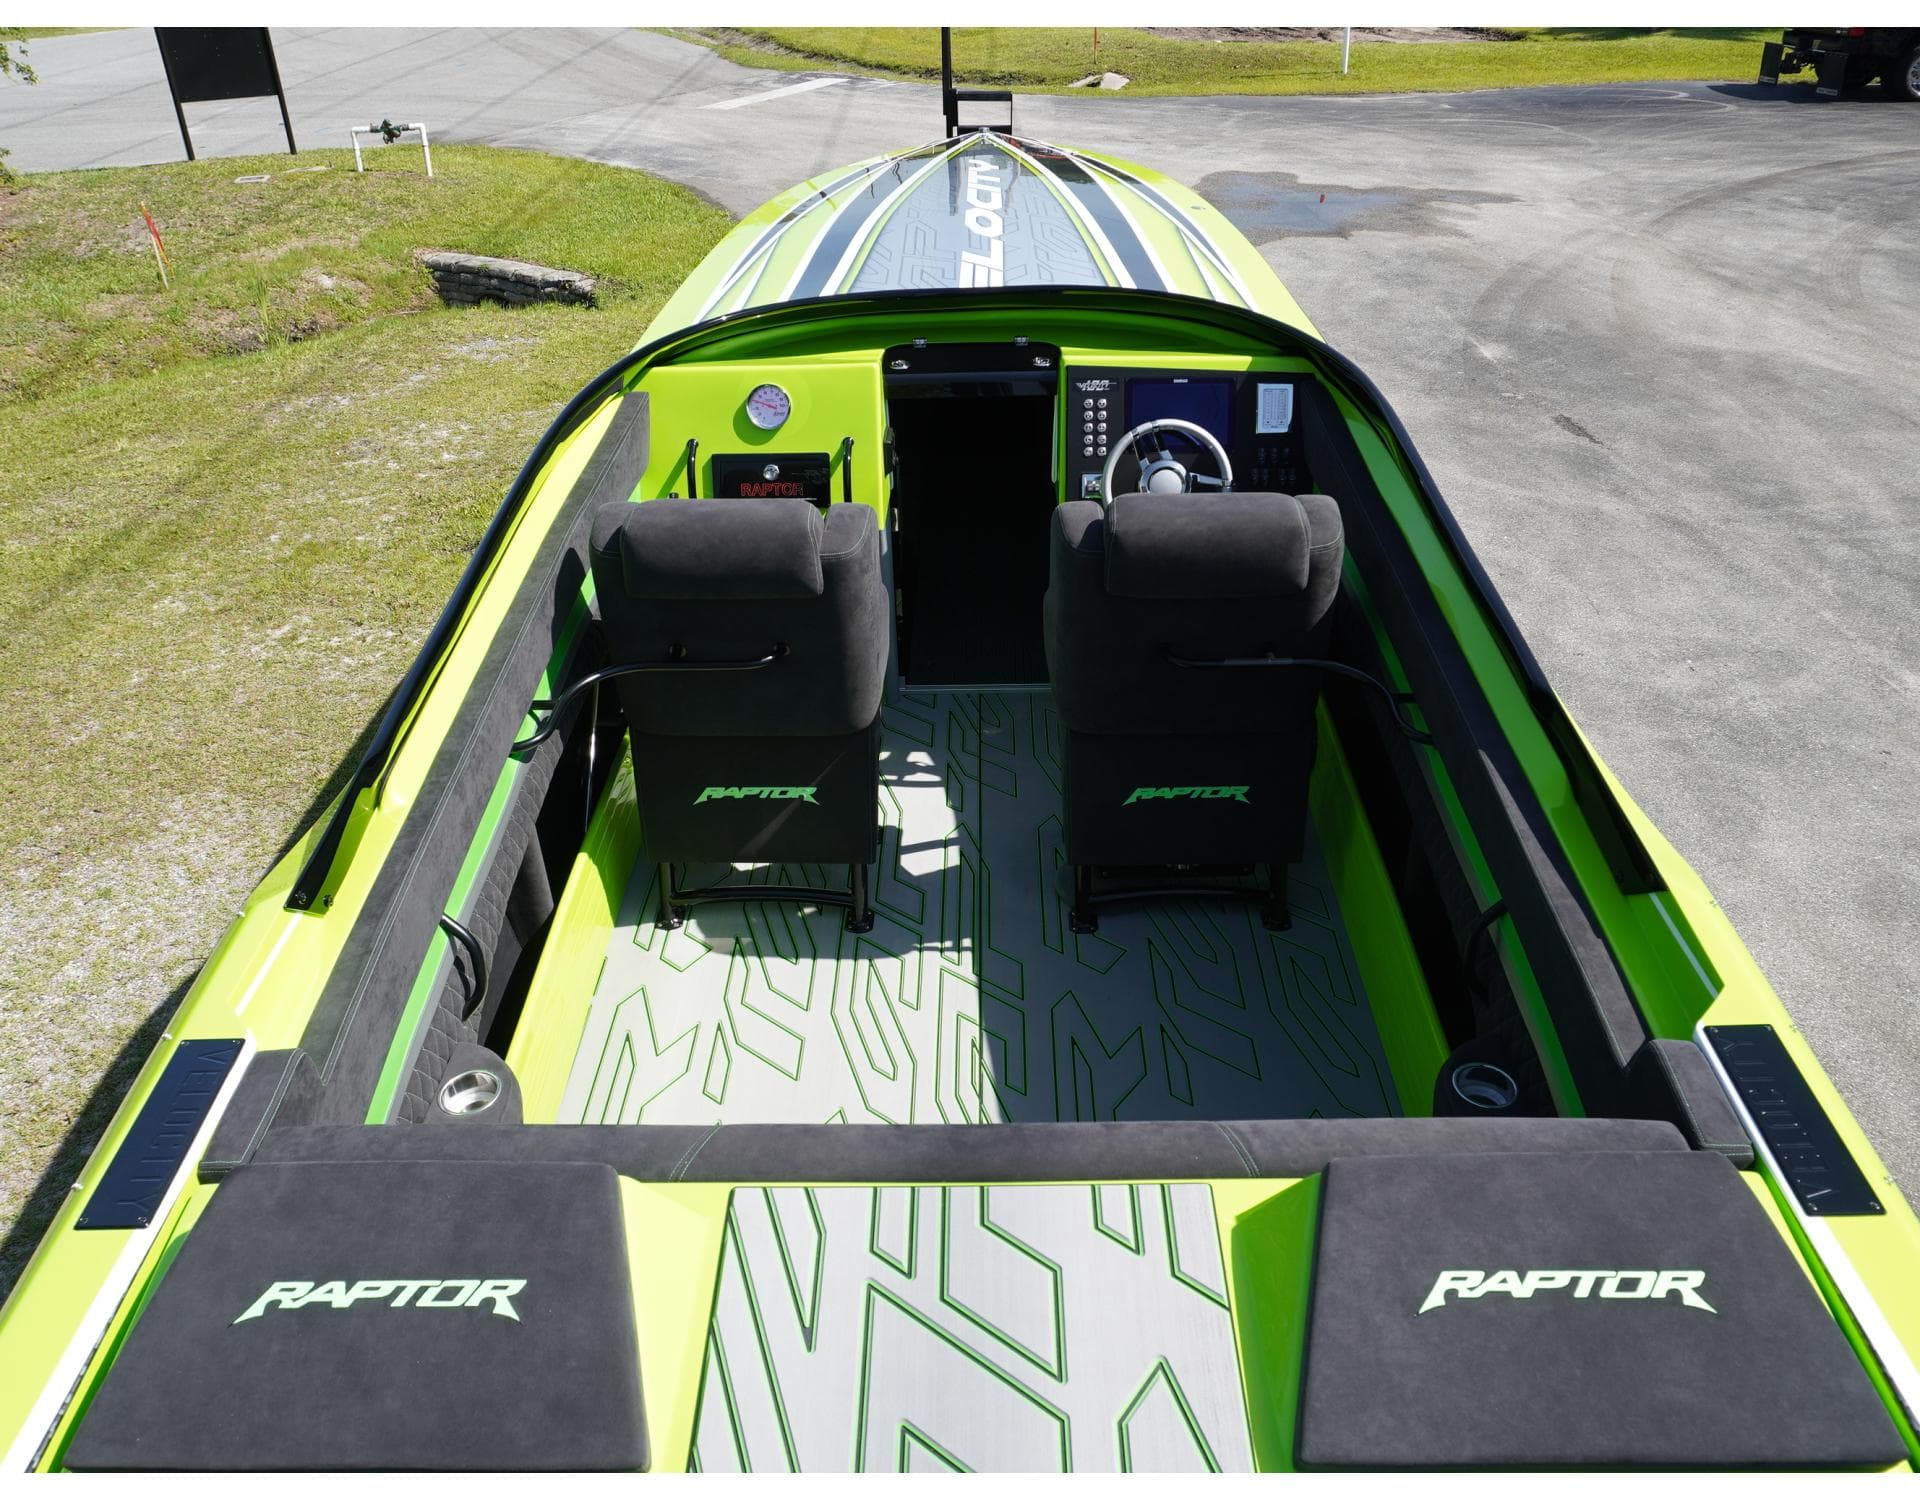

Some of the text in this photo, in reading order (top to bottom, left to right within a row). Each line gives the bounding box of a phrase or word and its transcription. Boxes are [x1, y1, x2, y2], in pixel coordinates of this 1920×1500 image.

[959, 159, 1004, 288] ELOCITY
[741, 482, 803, 497] RAPTOR
[692, 786, 820, 806] RAPTOR
[1121, 786, 1251, 806] RAPTOR
[116, 1047, 234, 1213] VELOCITY
[231, 1279, 528, 1326] RAPTOR
[1416, 1270, 1718, 1315] RAPTOR
